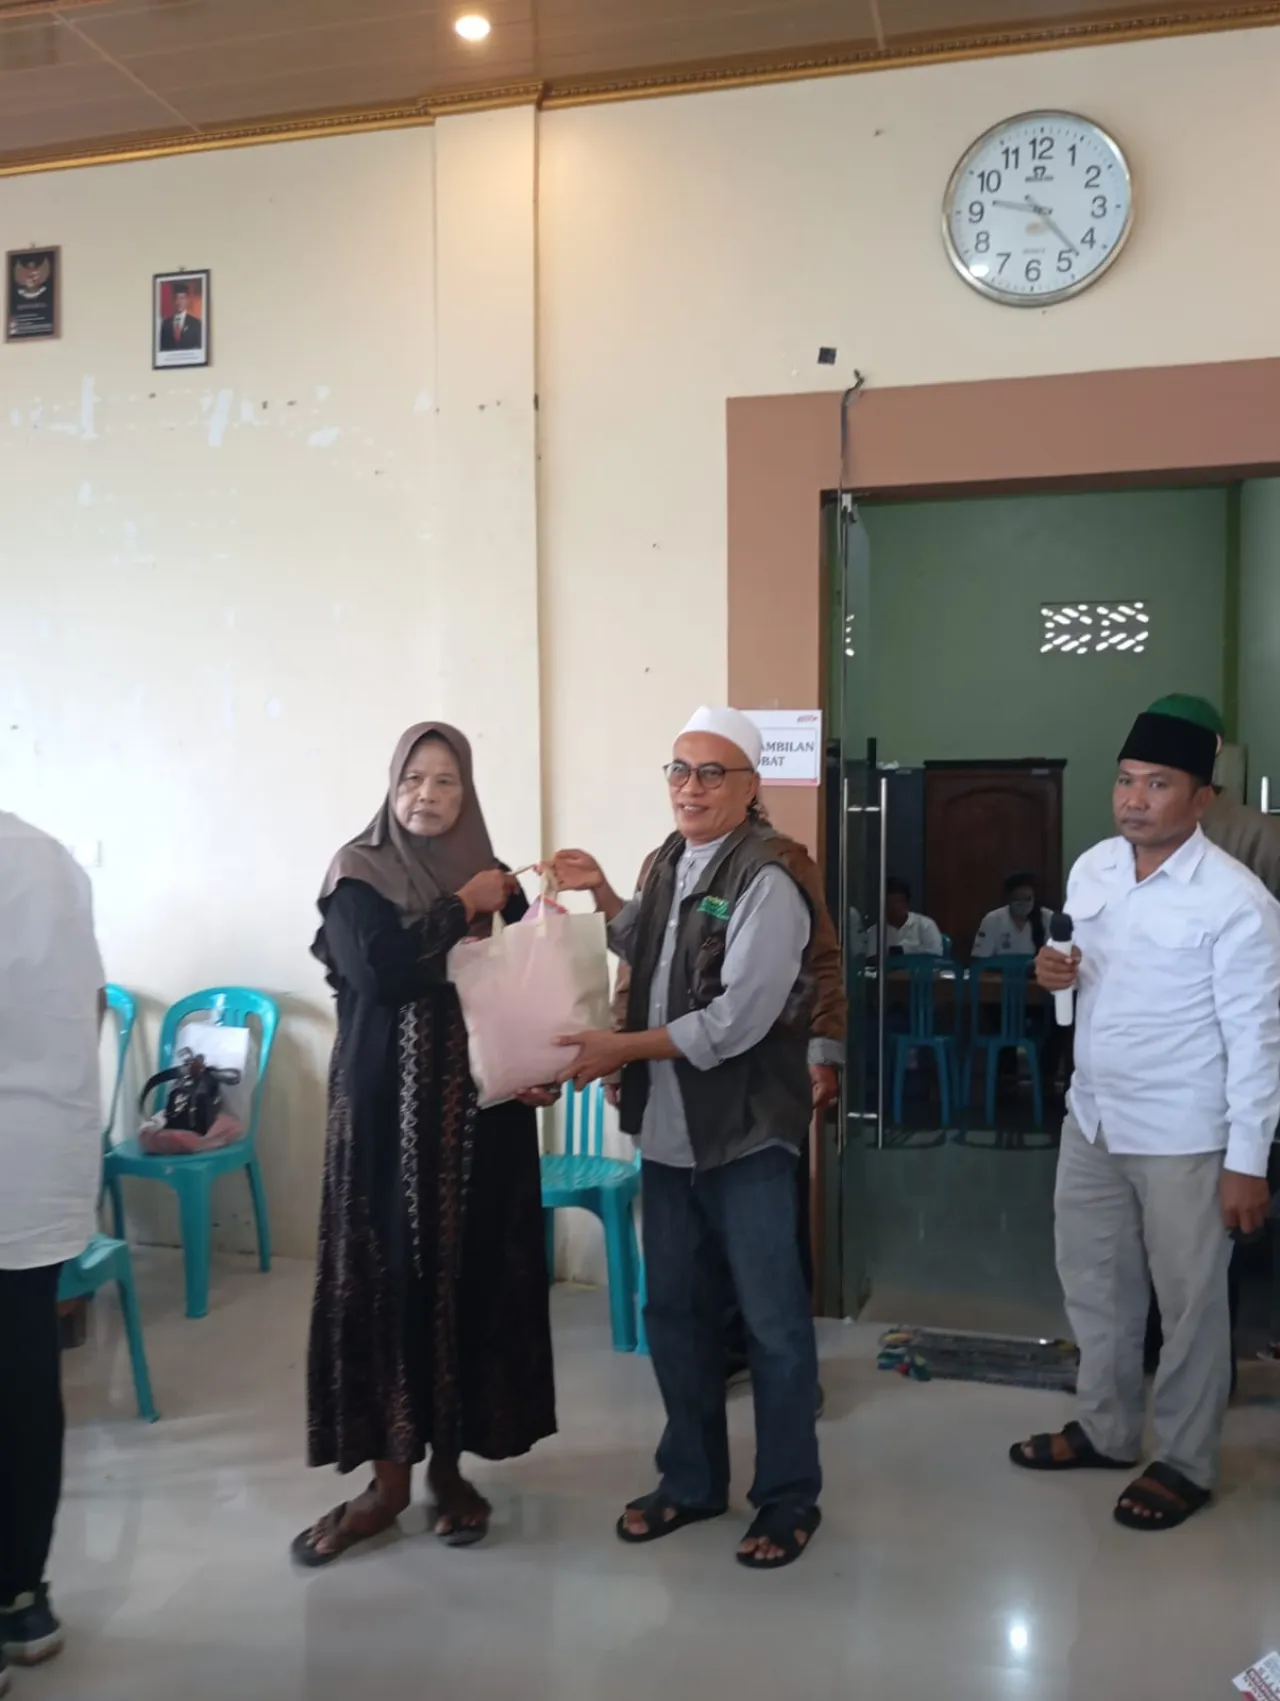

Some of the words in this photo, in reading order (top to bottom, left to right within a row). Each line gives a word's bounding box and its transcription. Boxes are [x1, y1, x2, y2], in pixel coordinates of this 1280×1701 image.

[1001, 146, 1020, 170] 11
[1028, 136, 1054, 160] 12
[1067, 143, 1077, 167] 1
[977, 169, 1001, 194] 10
[1084, 165, 1101, 189] 2
[968, 201, 985, 224] 9
[1090, 195, 1107, 219] 3
[974, 231, 990, 254] 8
[1080, 227, 1096, 250] 4
[996, 252, 1011, 275] 7
[1024, 259, 1041, 282] 6
[1056, 249, 1073, 273] 5
